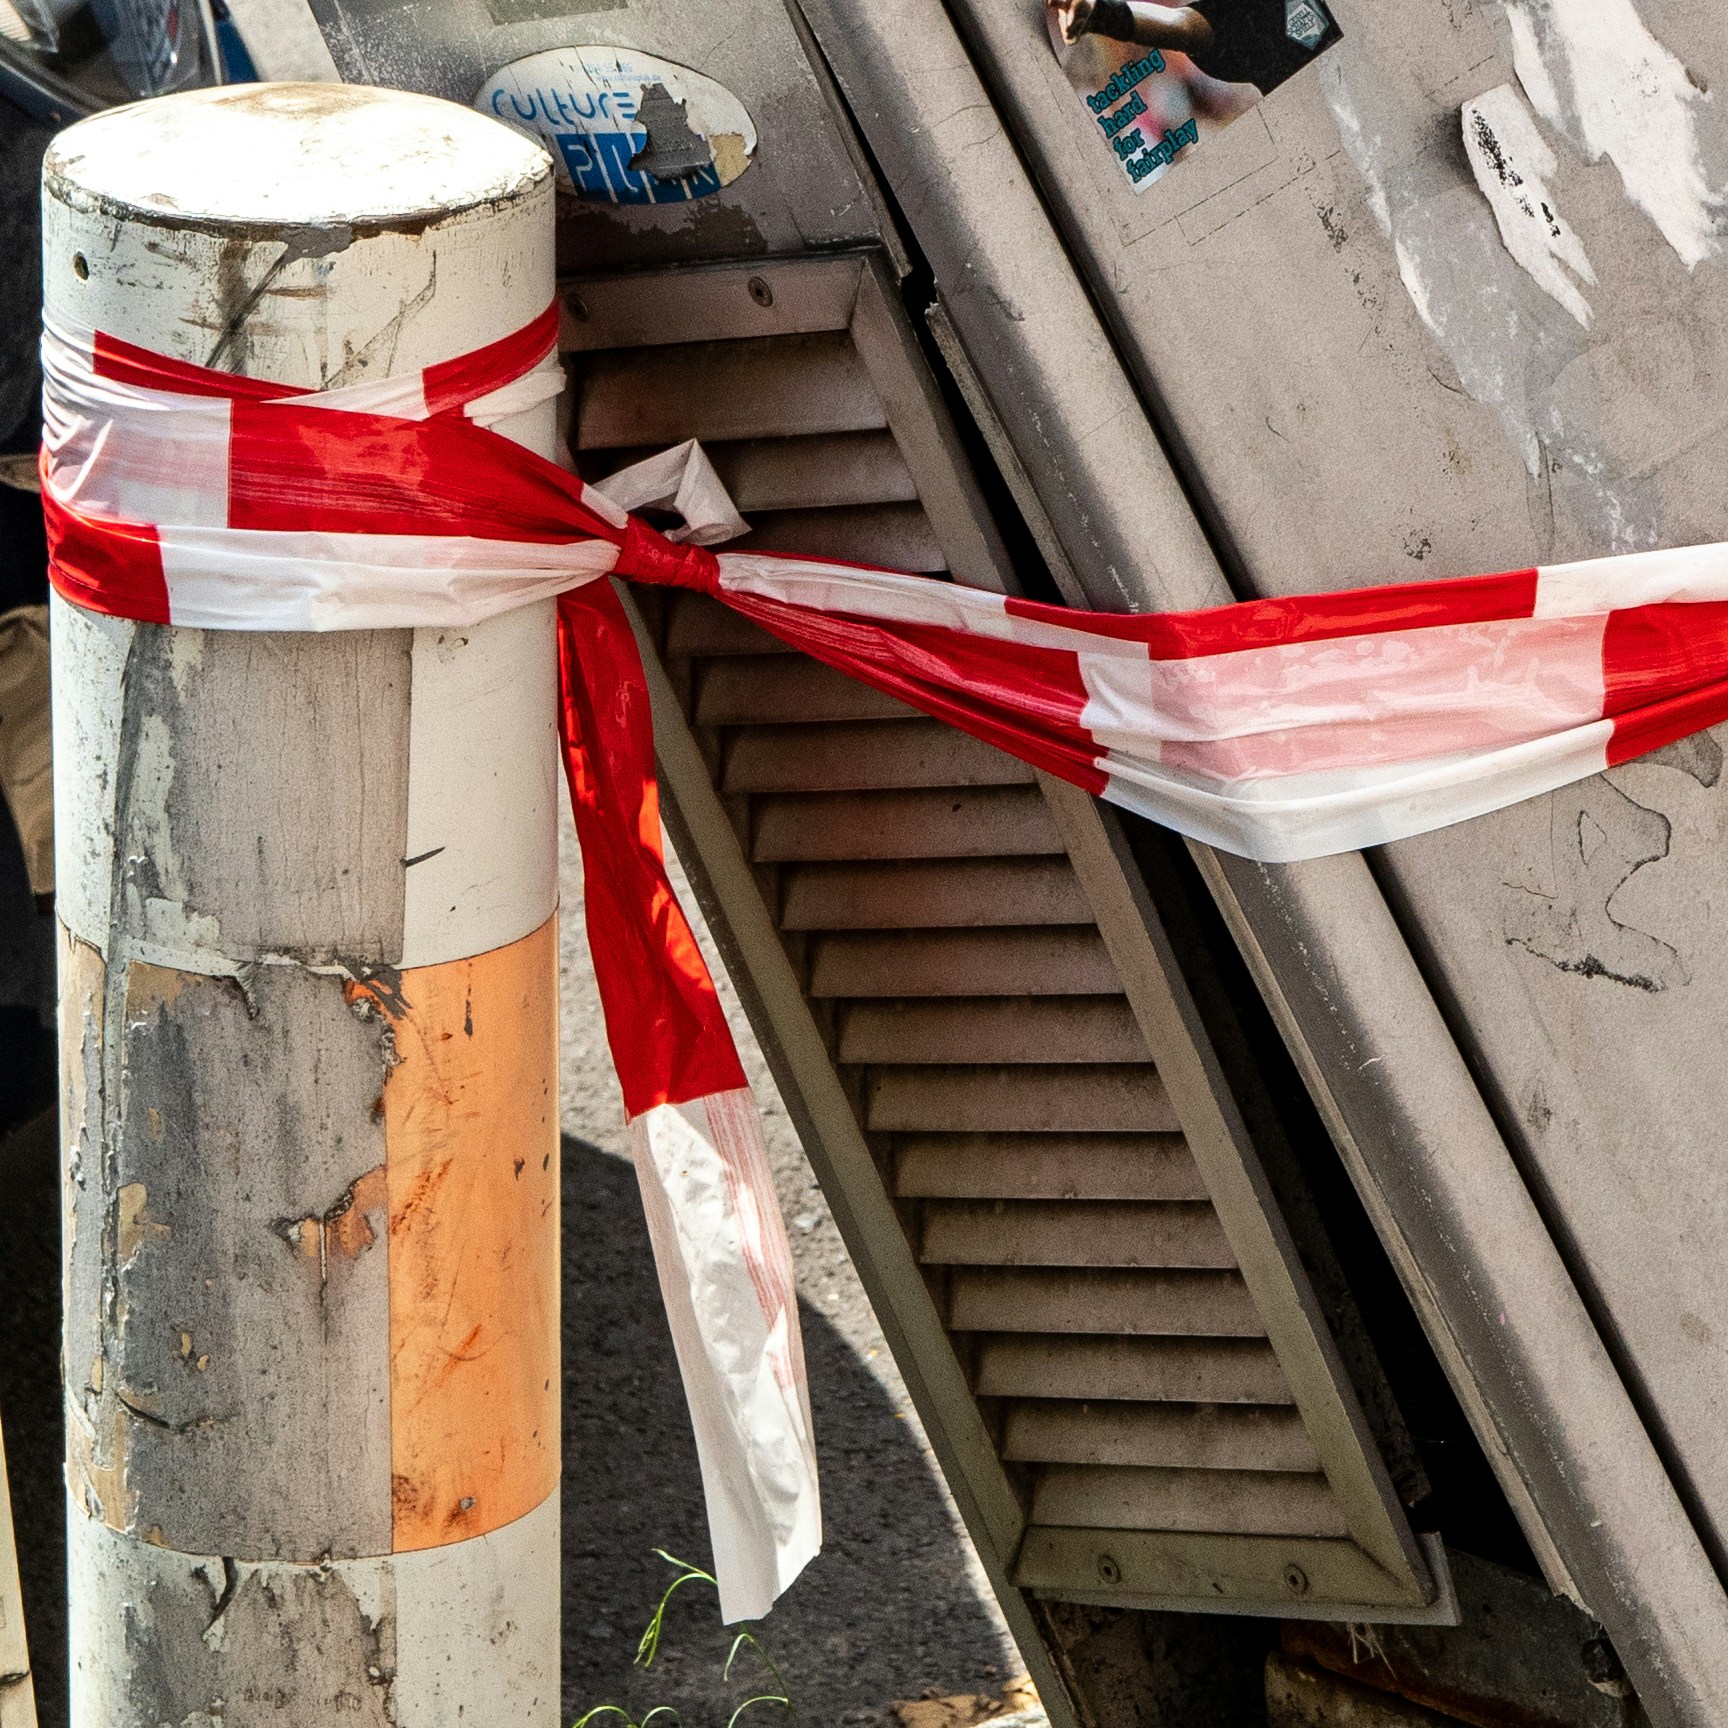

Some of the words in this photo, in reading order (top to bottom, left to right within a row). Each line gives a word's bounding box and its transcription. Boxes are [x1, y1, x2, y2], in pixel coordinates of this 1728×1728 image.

[1086, 48, 1166, 114] tackling
[1097, 90, 1148, 139] hard
[1113, 128, 1145, 161] for
[1126, 118, 1199, 183] fairplay
